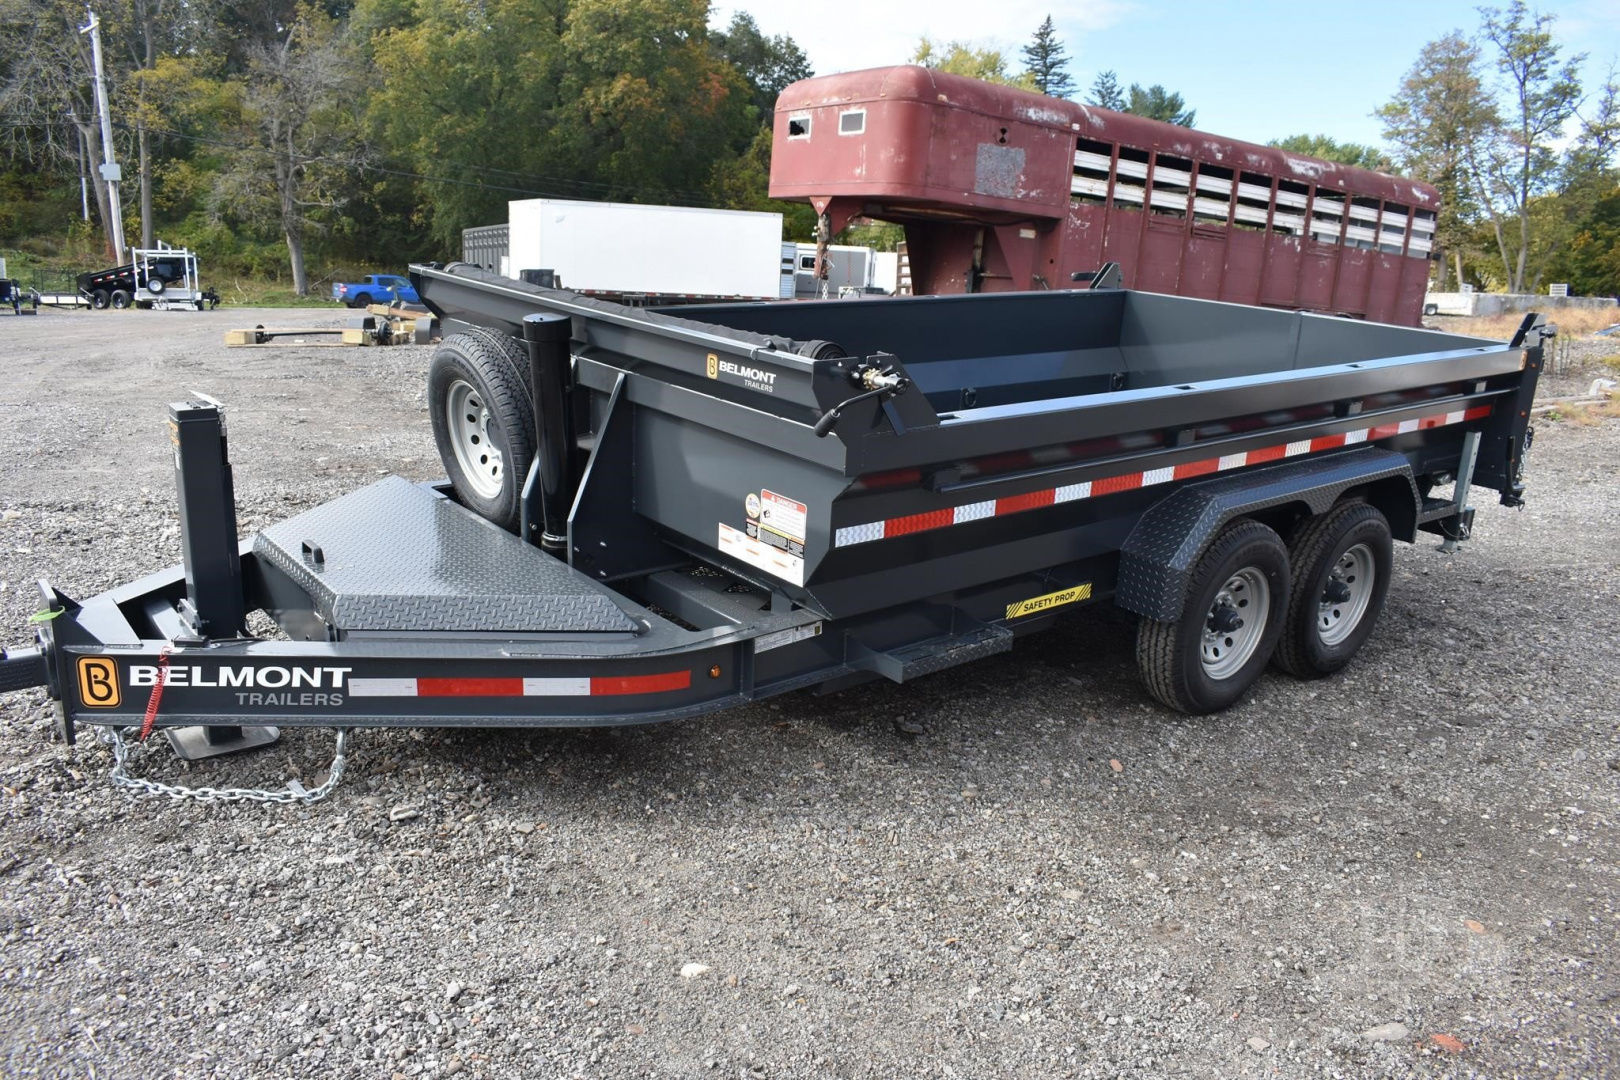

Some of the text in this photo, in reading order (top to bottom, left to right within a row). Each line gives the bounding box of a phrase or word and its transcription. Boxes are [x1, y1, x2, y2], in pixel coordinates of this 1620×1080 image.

[719, 360, 777, 384] BELMONT
[744, 379, 774, 393] TRAILERS
[1023, 591, 1076, 612] SAFETY PROP
[129, 665, 353, 688] BELMONT
[234, 692, 344, 706] TRAILERS
